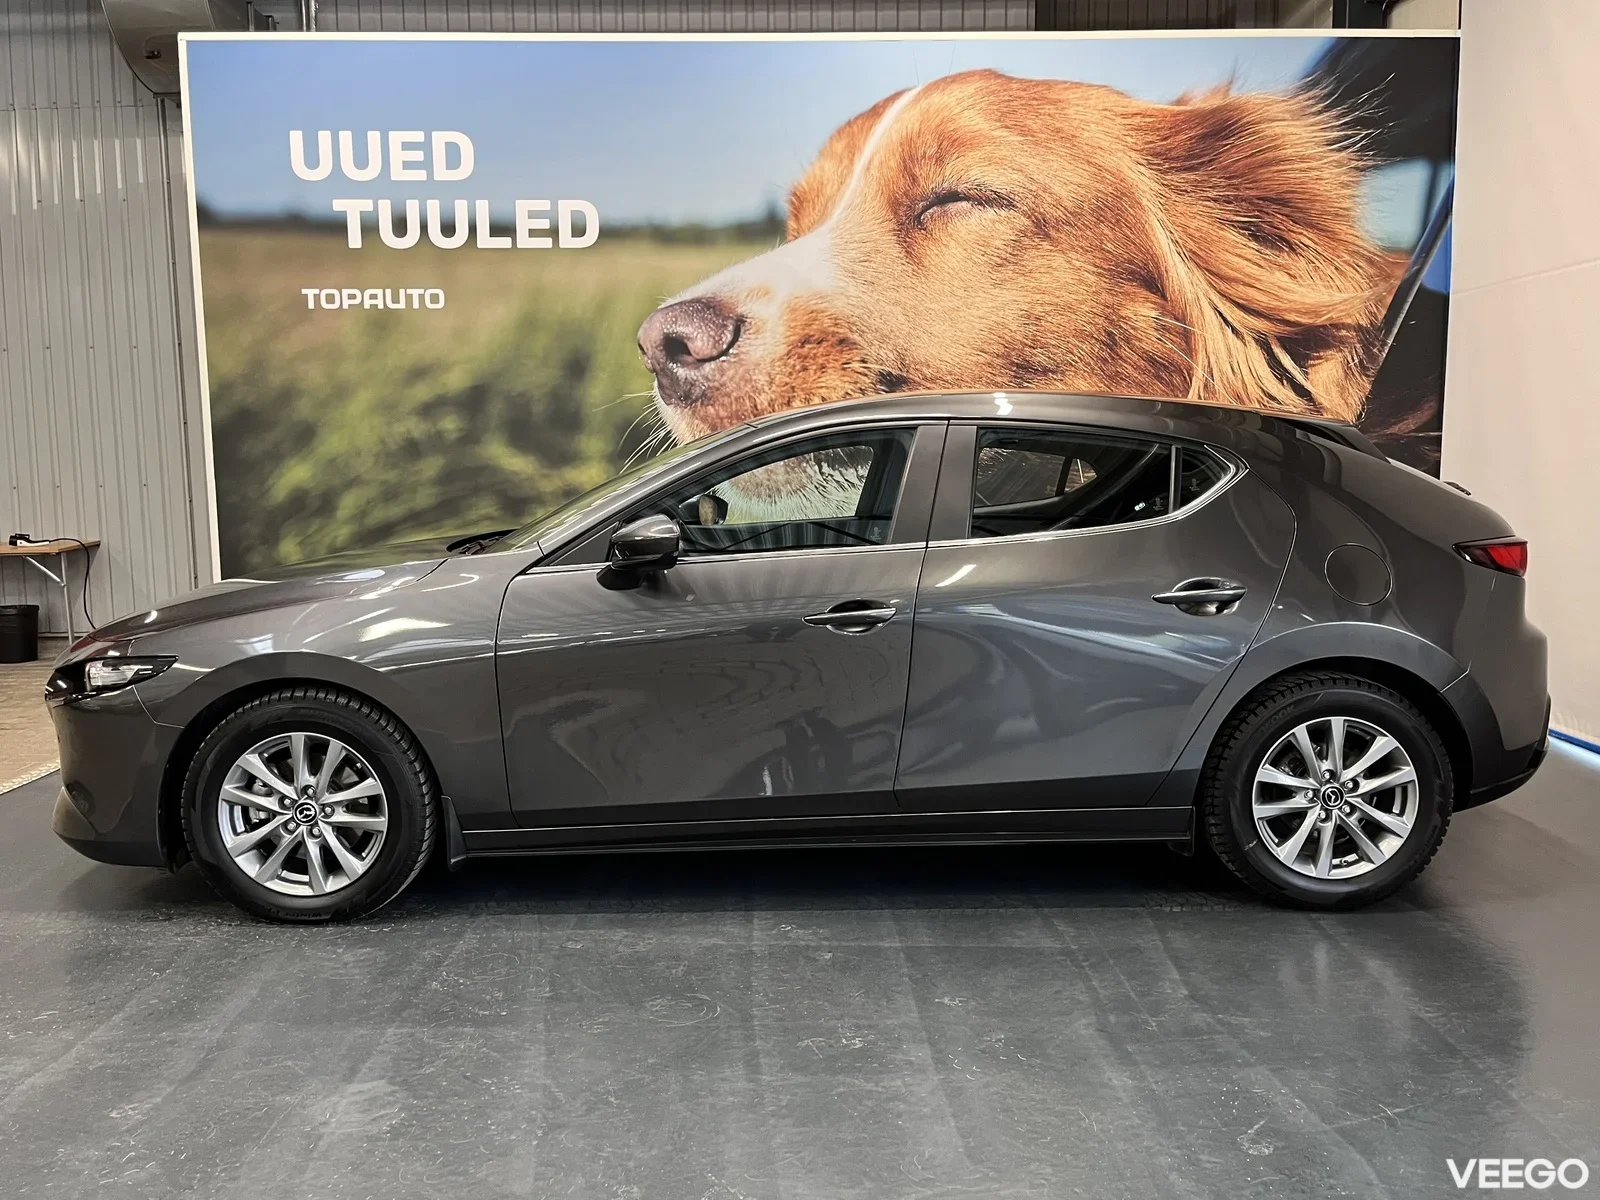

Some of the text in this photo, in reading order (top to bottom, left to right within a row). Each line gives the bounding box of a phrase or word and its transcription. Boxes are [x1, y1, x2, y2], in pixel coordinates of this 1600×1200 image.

[289, 130, 475, 182] UUED
[332, 198, 600, 249] TUULED
[301, 288, 446, 310] TOPAUTO
